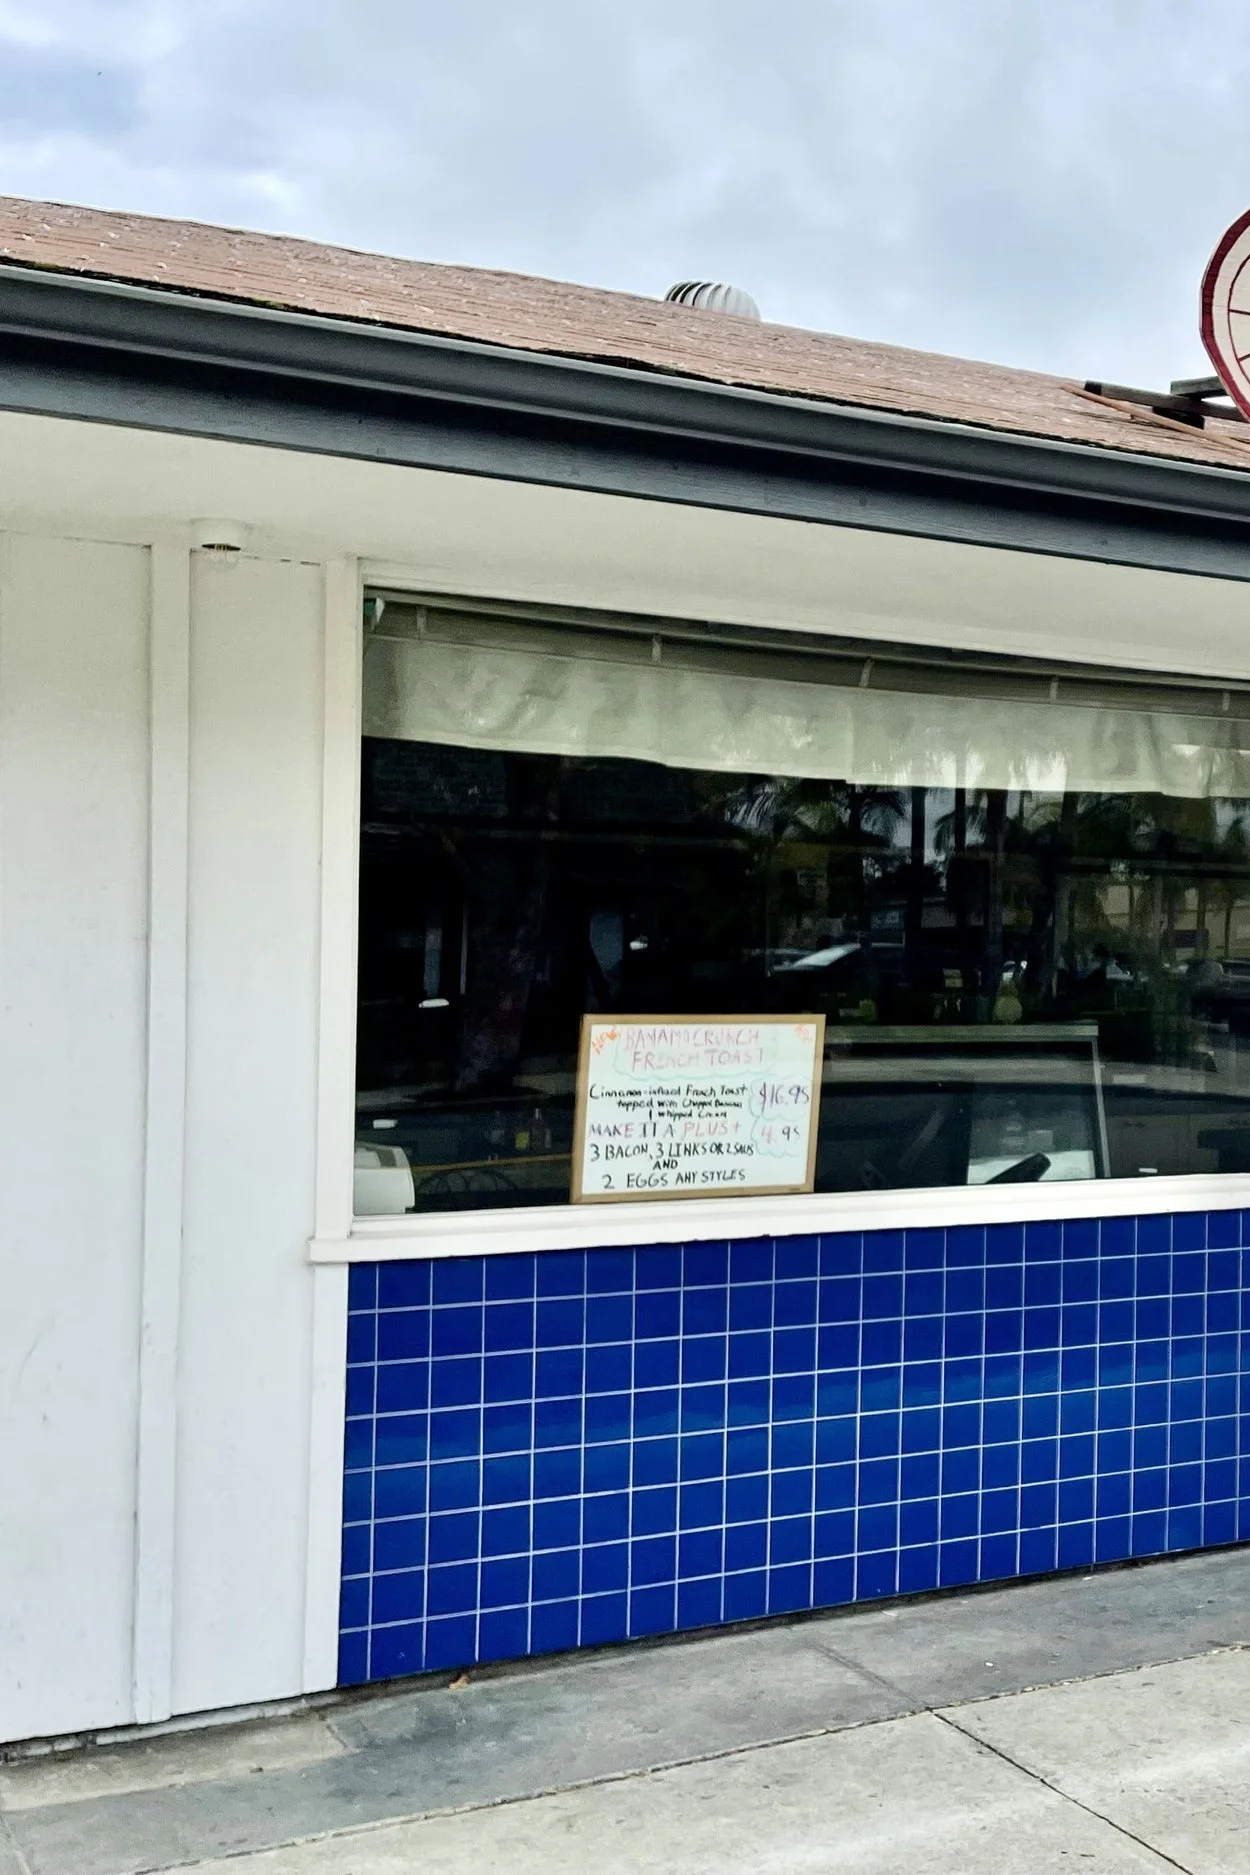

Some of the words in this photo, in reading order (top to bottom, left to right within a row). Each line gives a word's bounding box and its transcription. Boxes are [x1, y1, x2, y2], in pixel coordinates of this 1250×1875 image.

[694, 1028, 759, 1047] CRUNCH
[631, 1051, 700, 1072] FRENCH
[704, 1048, 763, 1066] TOAST
[760, 1081, 810, 1114] $16.95
[589, 1122, 633, 1138] MAKE
[641, 1121, 661, 1138] IT
[663, 1122, 675, 1138] A
[590, 1143, 601, 1162] 3
[656, 1142, 665, 1159] 3
[669, 1142, 707, 1158] LINKS
[709, 1142, 724, 1156] OR
[653, 1160, 678, 1170] AND
[602, 1174, 615, 1190] 2
[627, 1173, 669, 1188] EGGS
[675, 1171, 698, 1185] ANY
[701, 1169, 746, 1183] STYLES
